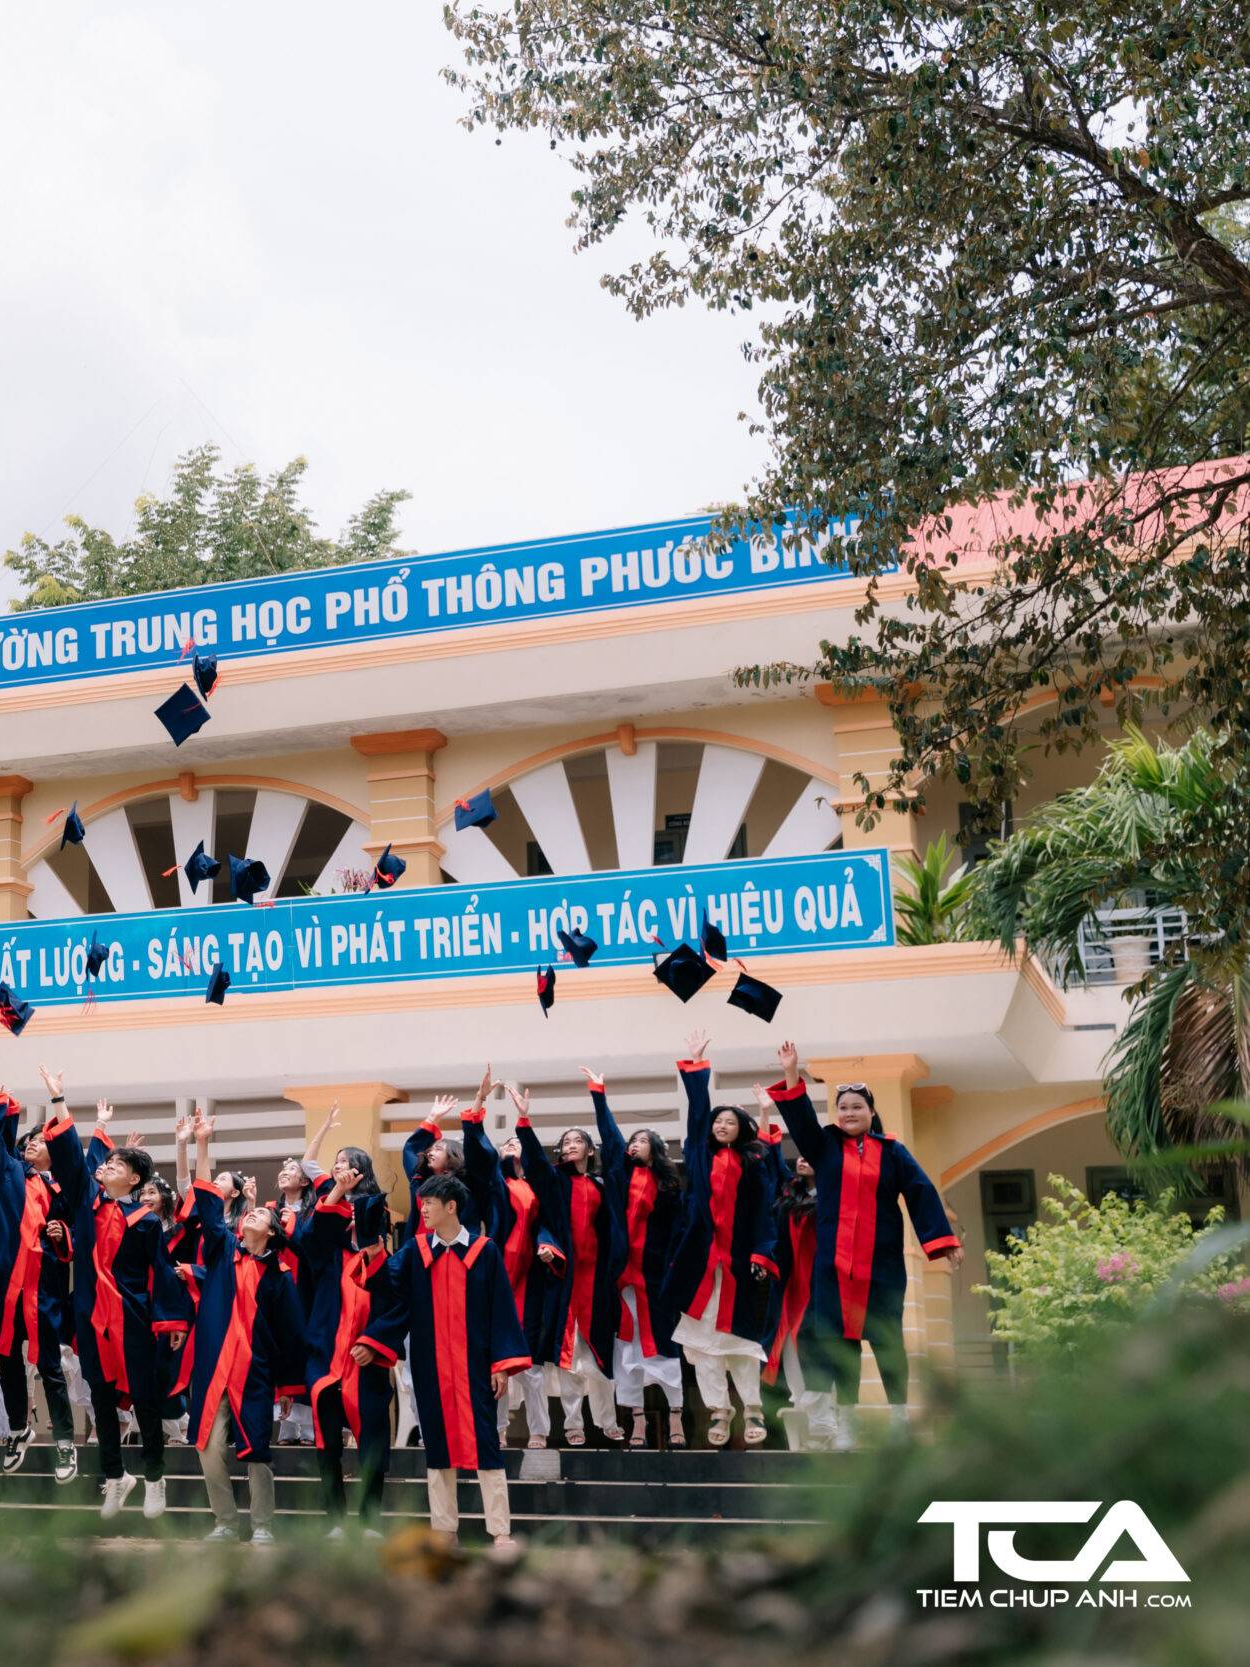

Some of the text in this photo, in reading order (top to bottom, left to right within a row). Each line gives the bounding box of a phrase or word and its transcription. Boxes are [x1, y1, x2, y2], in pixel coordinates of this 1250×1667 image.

[90, 608, 218, 660] TRUNG
[231, 596, 312, 646] HỌC
[325, 567, 409, 631] PHỔ
[421, 562, 566, 617] THÔNG
[579, 534, 735, 597] PHƯỚC
[147, 927, 220, 980] SÁNG
[228, 930, 284, 982] TẠO
[295, 915, 322, 968] VÌ
[331, 911, 406, 966] PHÁT
[413, 894, 503, 961] TRIỂN
[528, 898, 589, 962] HỢP
[596, 890, 659, 946] TÁC
[666, 884, 699, 941] VÌ
[707, 880, 785, 947] HIỆU
[793, 866, 864, 934] QUẢ
